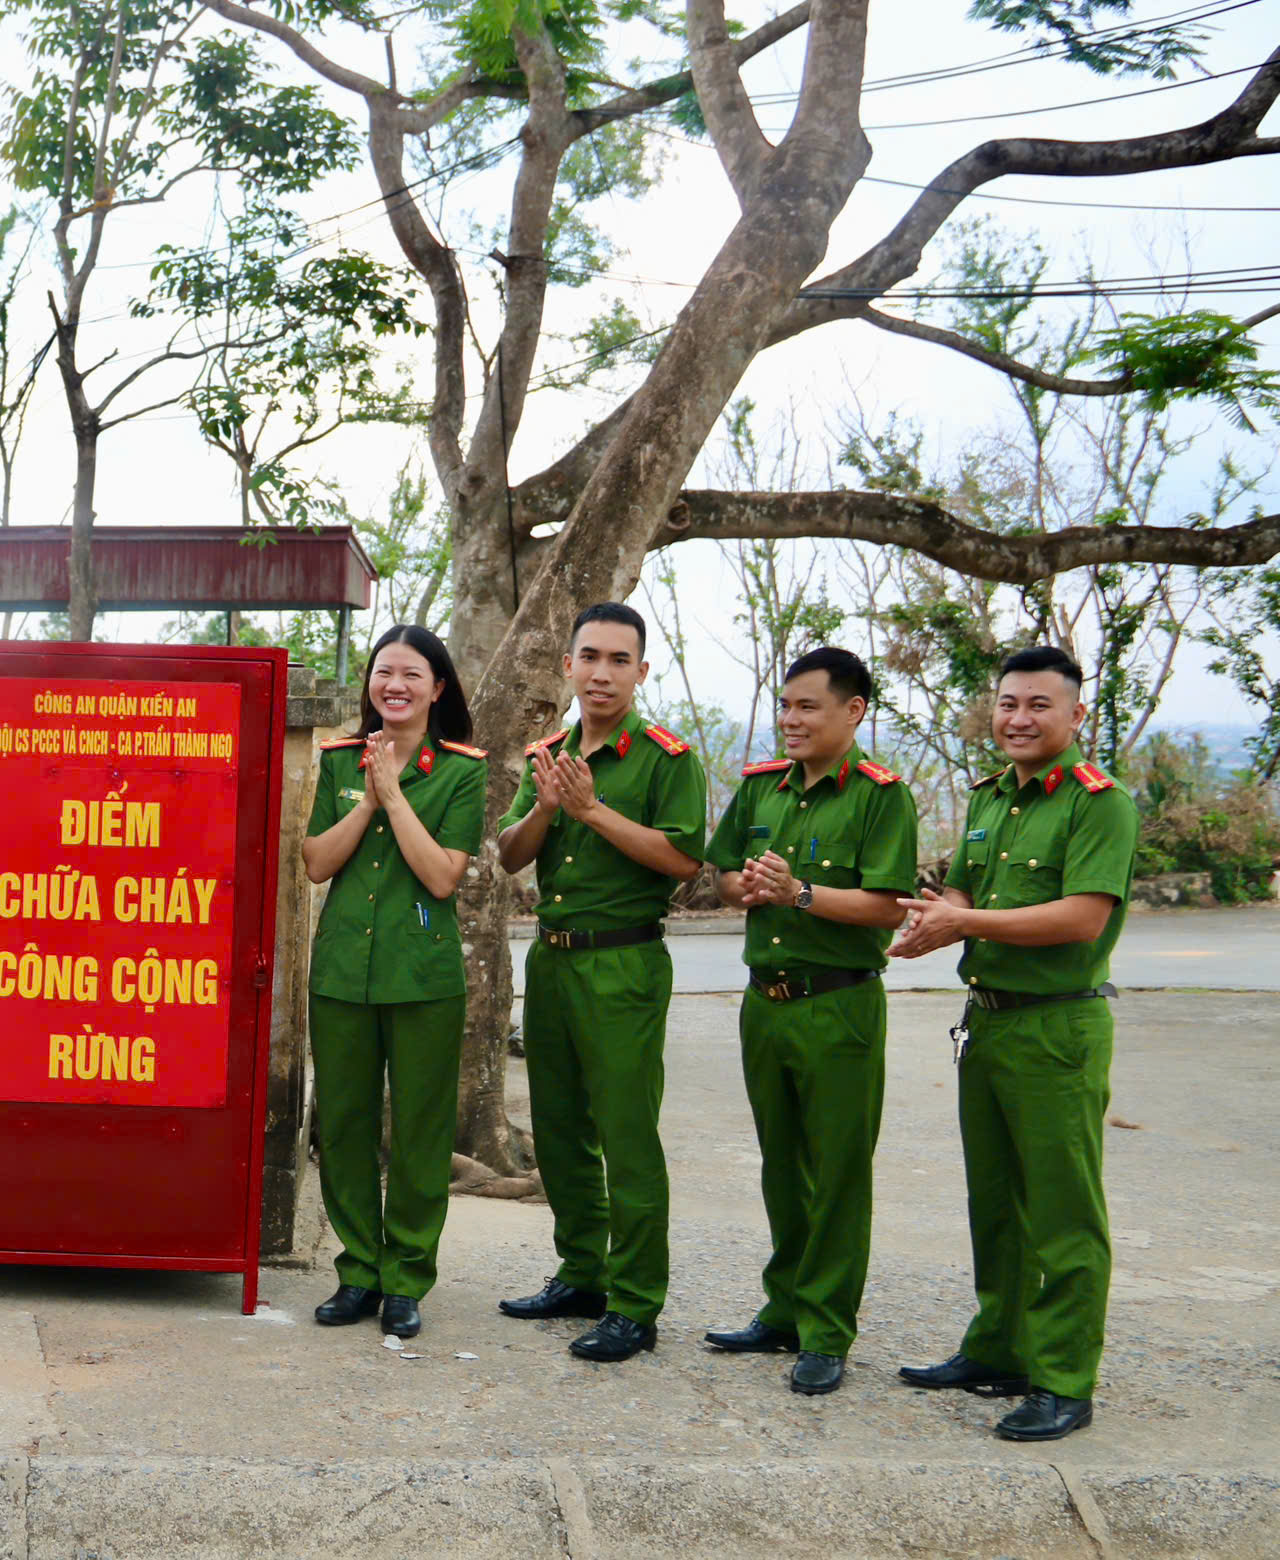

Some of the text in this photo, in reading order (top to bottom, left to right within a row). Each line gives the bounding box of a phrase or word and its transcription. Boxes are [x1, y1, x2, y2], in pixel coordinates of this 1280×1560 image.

[34, 690, 197, 720] CÔNG AN QUẬN KIẾN AN
[15, 728, 29, 753] CS
[32, 728, 60, 753] PCCC
[63, 724, 77, 754] VÀ
[79, 730, 109, 755] CNCH
[118, 731, 132, 755] CA
[174, 728, 208, 757] THÀNH
[210, 732, 233, 763] NGỌ
[60, 780, 161, 848] ĐIỂM
[114, 867, 217, 924] CHÁY
[111, 947, 218, 1013] CỘNG
[48, 1024, 156, 1082] RỪNG
